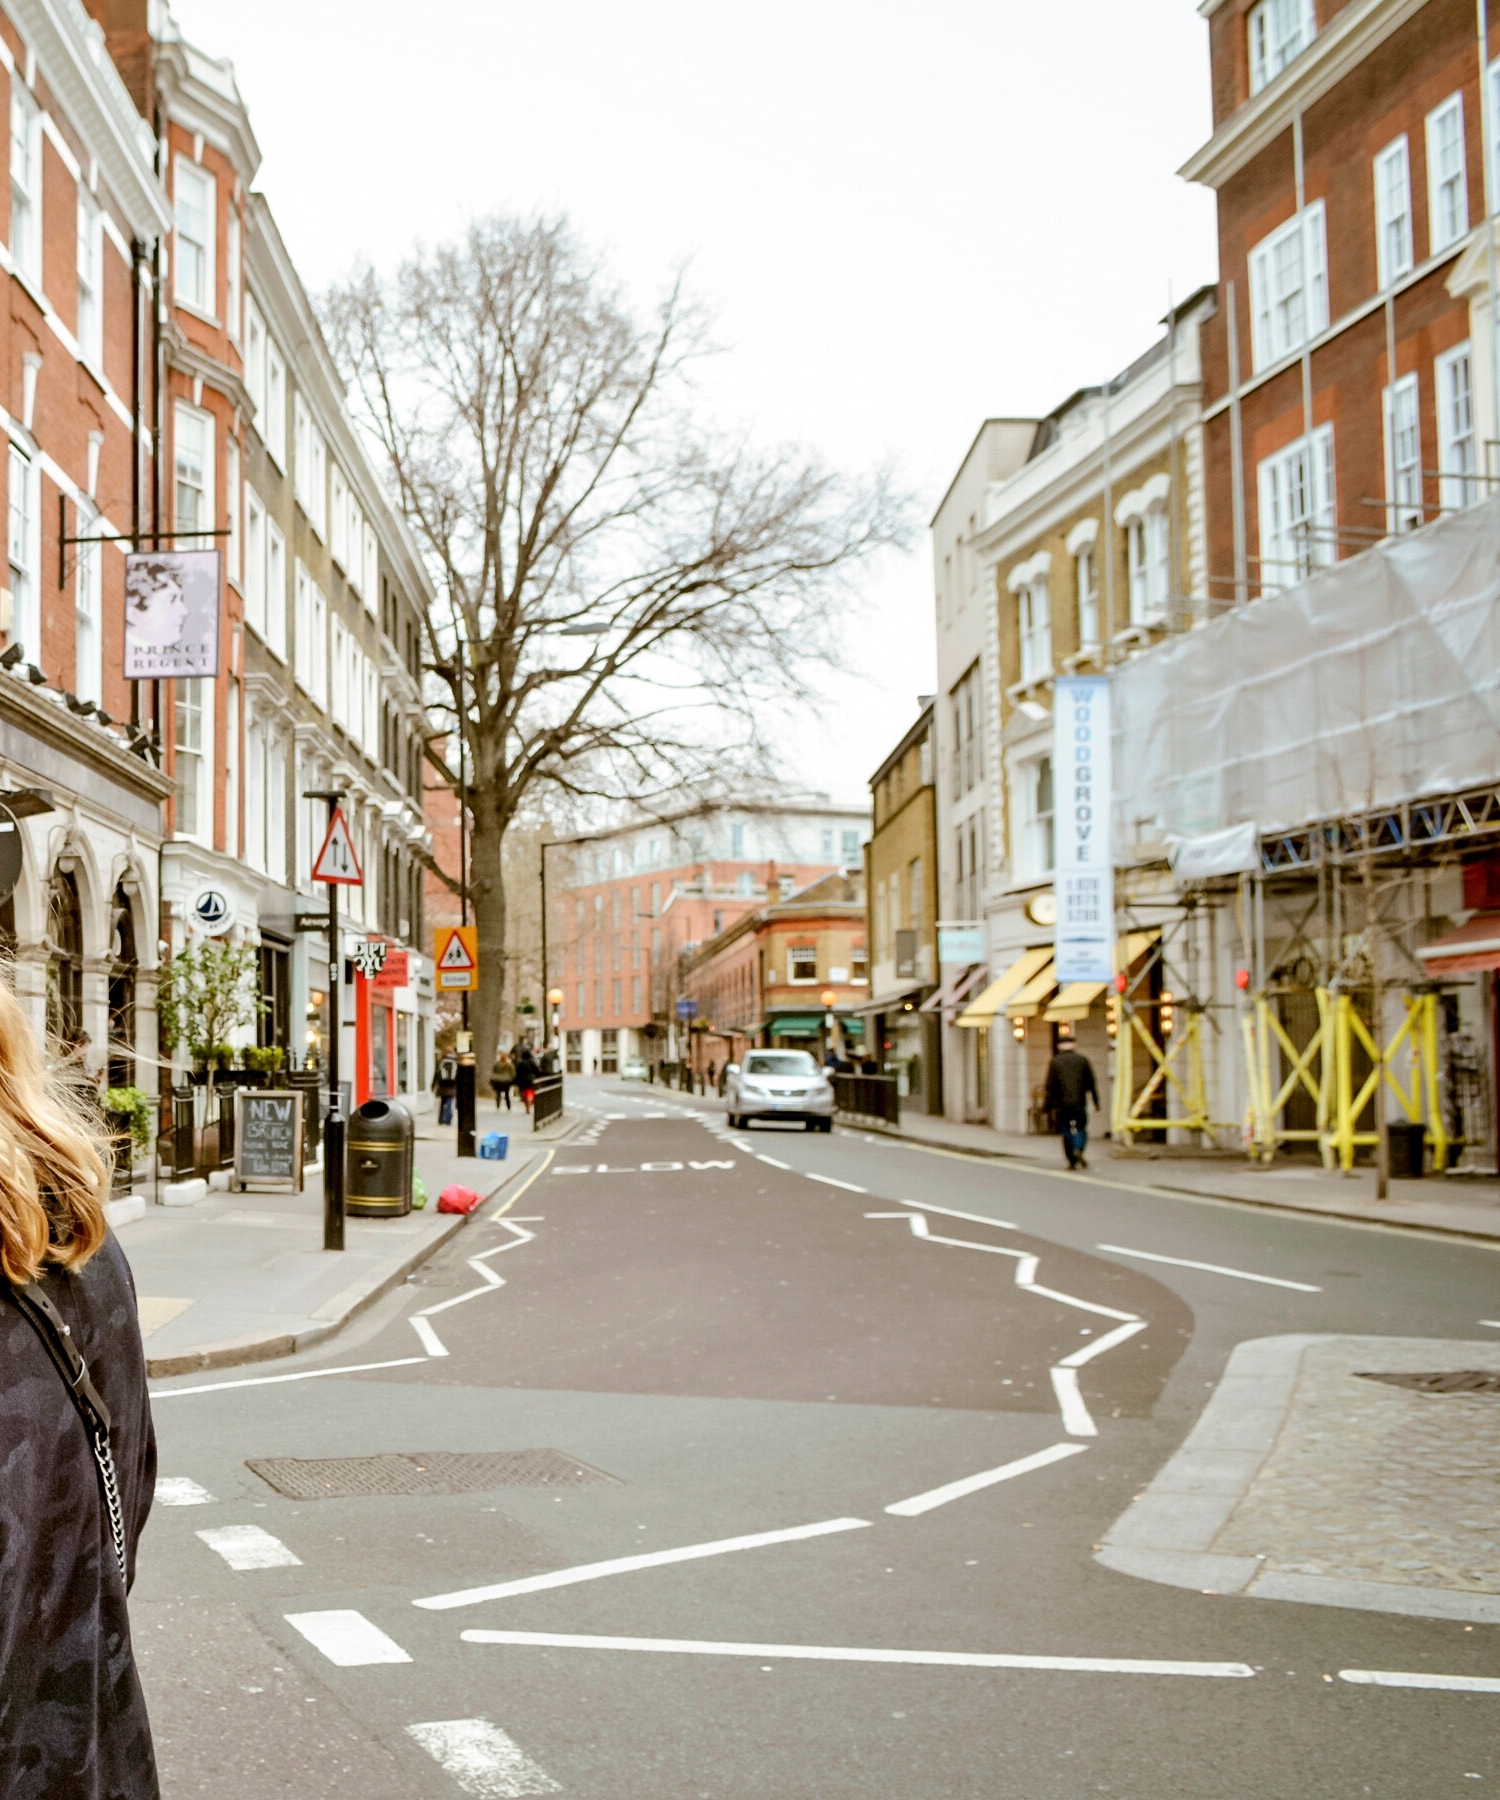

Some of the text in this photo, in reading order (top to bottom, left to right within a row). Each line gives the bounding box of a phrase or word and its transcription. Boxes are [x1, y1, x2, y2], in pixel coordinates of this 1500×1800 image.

[134, 643, 209, 656] PRINCE
[134, 657, 209, 669] REGENT
[1070, 686, 1095, 862] WOODGROVE
[250, 1100, 292, 1121] NEW
[551, 1159, 736, 1175] SLOW
